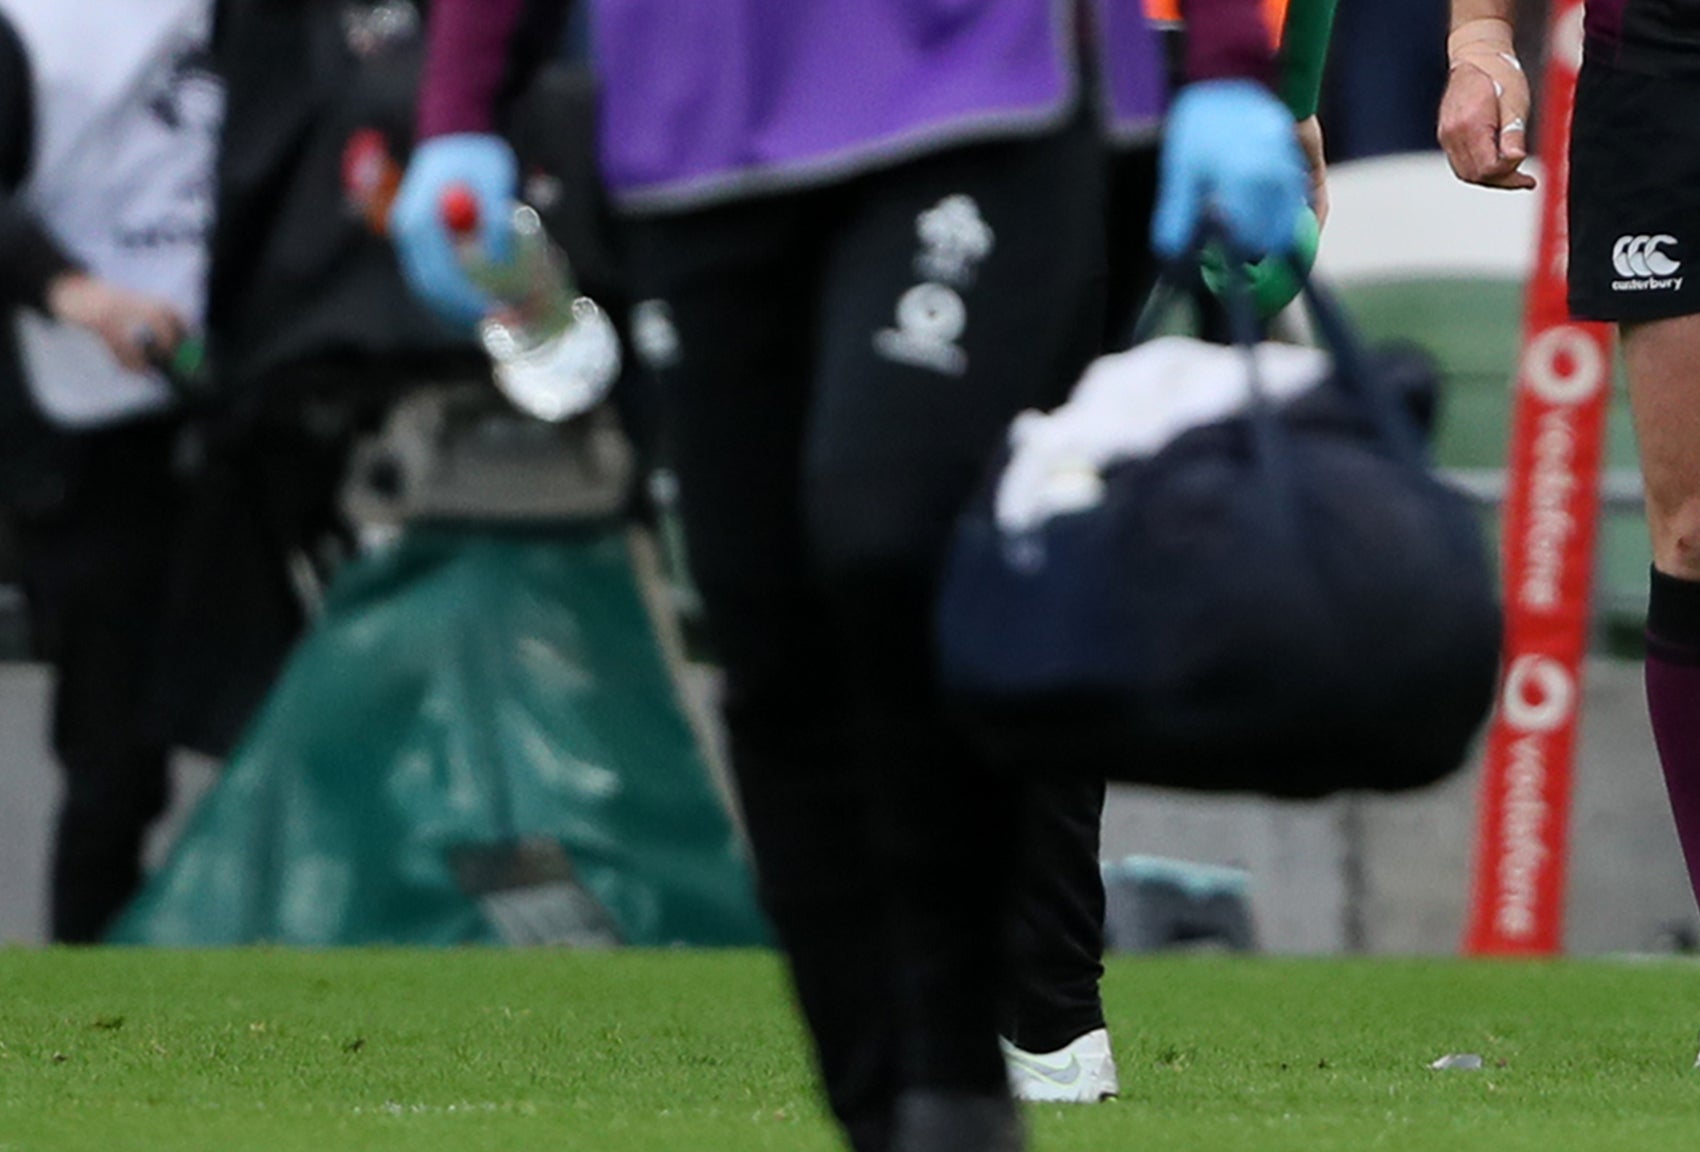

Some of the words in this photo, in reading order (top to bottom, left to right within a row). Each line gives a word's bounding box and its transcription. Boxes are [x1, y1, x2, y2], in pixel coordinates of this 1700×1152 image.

[1611, 275, 1684, 291] canterbury
[1524, 411, 1577, 607] vodafone
[1495, 734, 1549, 934] vodafone
